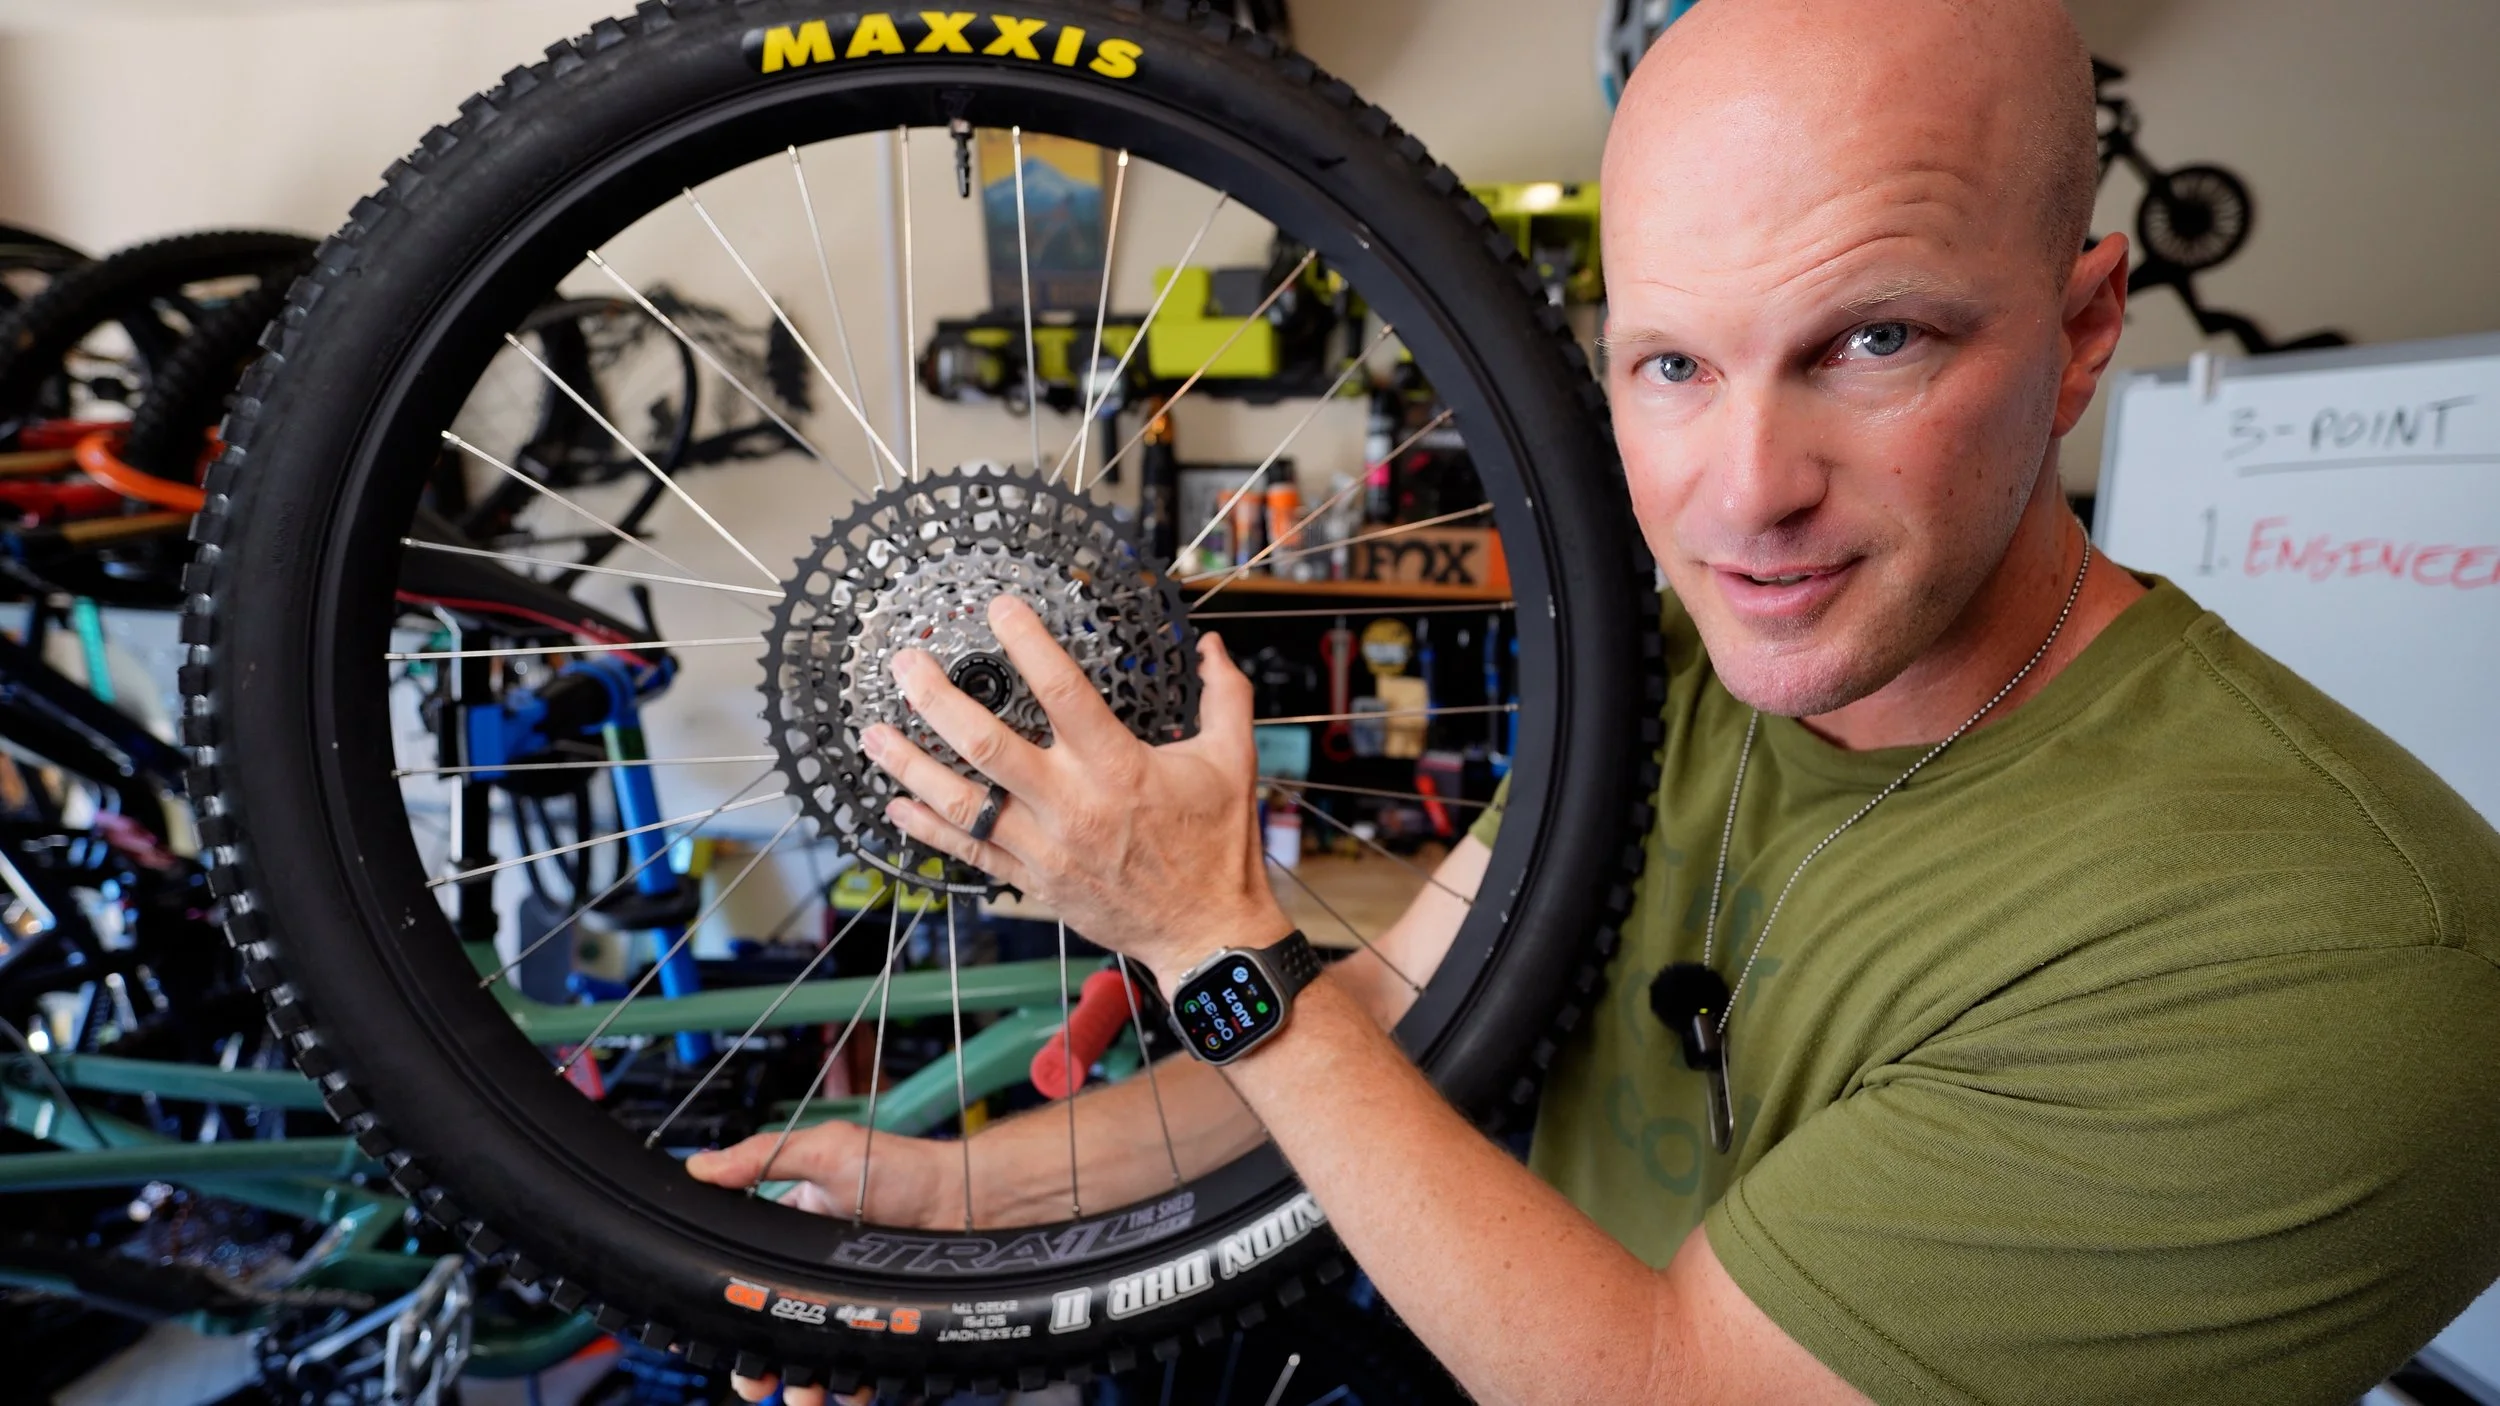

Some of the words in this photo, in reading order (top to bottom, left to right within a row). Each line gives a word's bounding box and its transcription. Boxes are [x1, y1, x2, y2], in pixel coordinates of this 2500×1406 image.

[761, 10, 1144, 79] MAXXIS
[1366, 538, 1479, 585] FOX
[1196, 990, 1235, 1042] 09:35
[1221, 987, 1239, 1004] 21
[1230, 1002, 1255, 1029] AUG
[1219, 1192, 1327, 1281] NION
[1107, 1248, 1214, 1319] DHR
[951, 1302, 974, 1315] TPI
[962, 1315, 985, 1328] PSI
